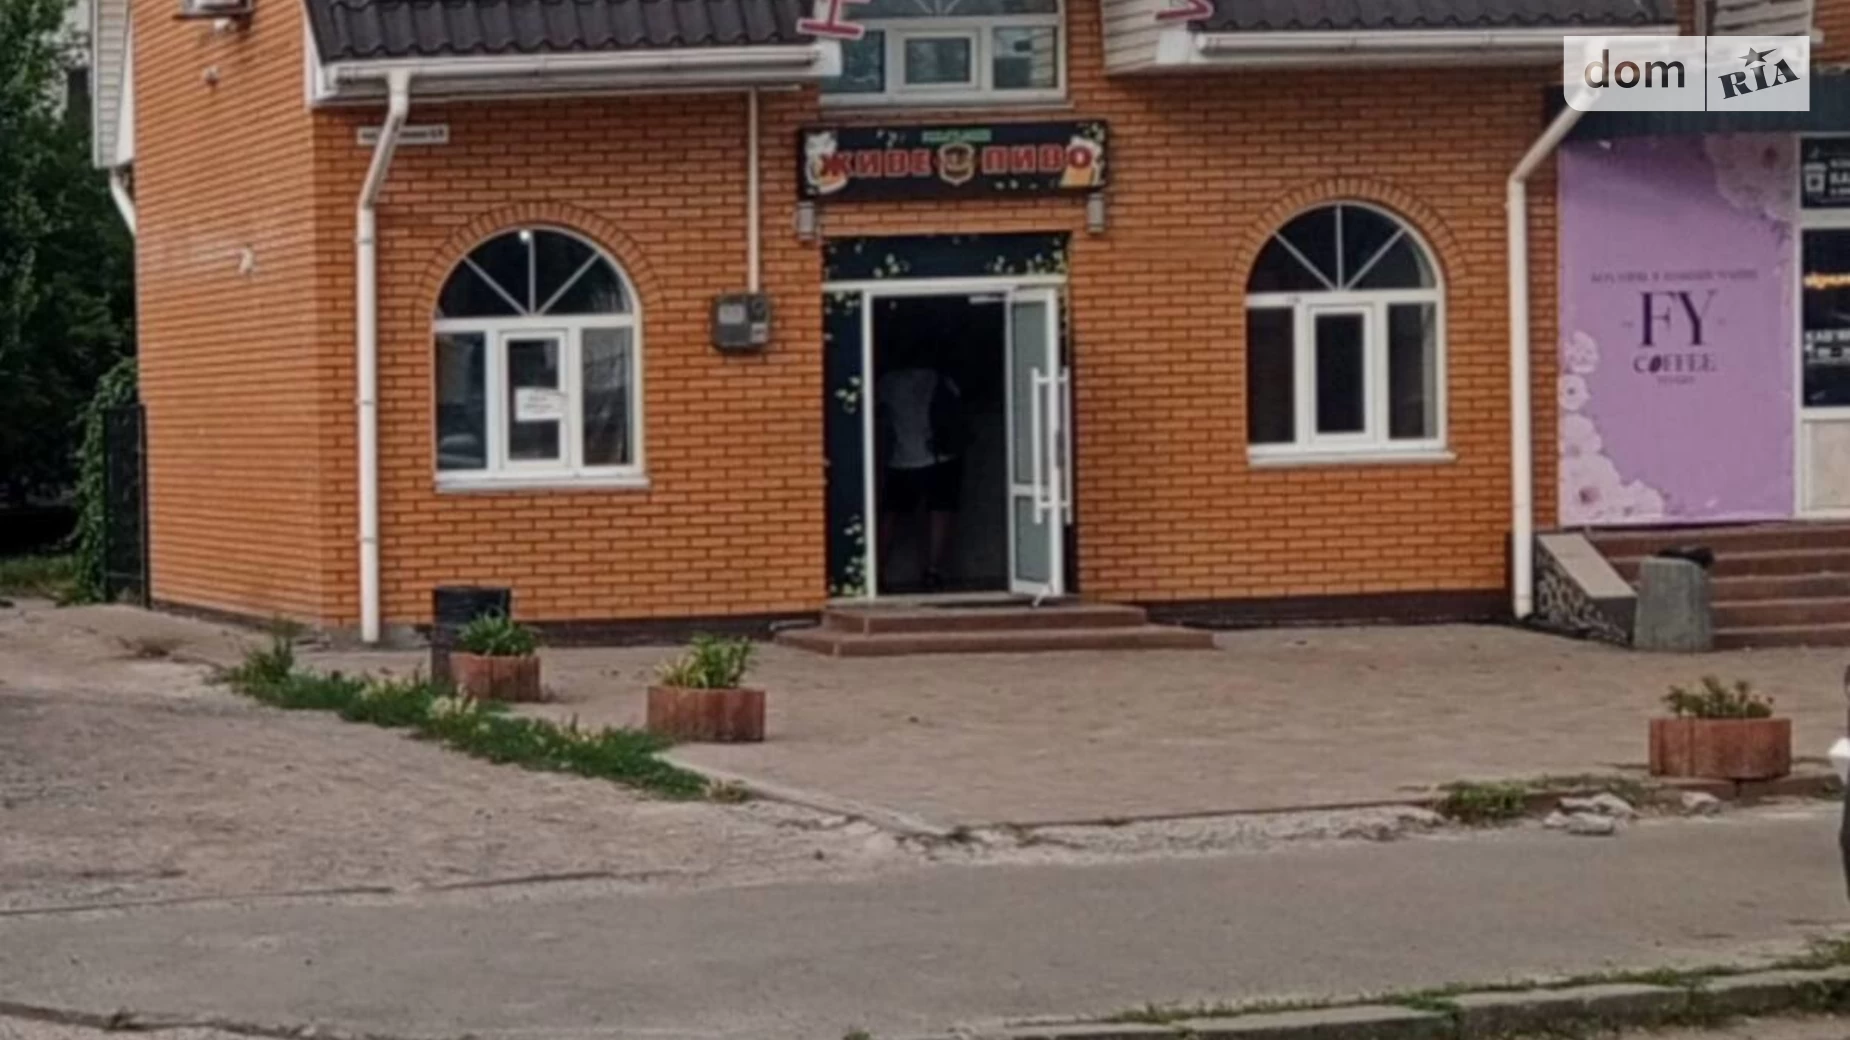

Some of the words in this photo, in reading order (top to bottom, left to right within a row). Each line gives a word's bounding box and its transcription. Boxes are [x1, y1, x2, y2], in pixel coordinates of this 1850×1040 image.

[817, 149, 933, 179] ЖИВЕ
[981, 145, 1094, 175] ПИВО
[1640, 288, 1717, 347] FY
